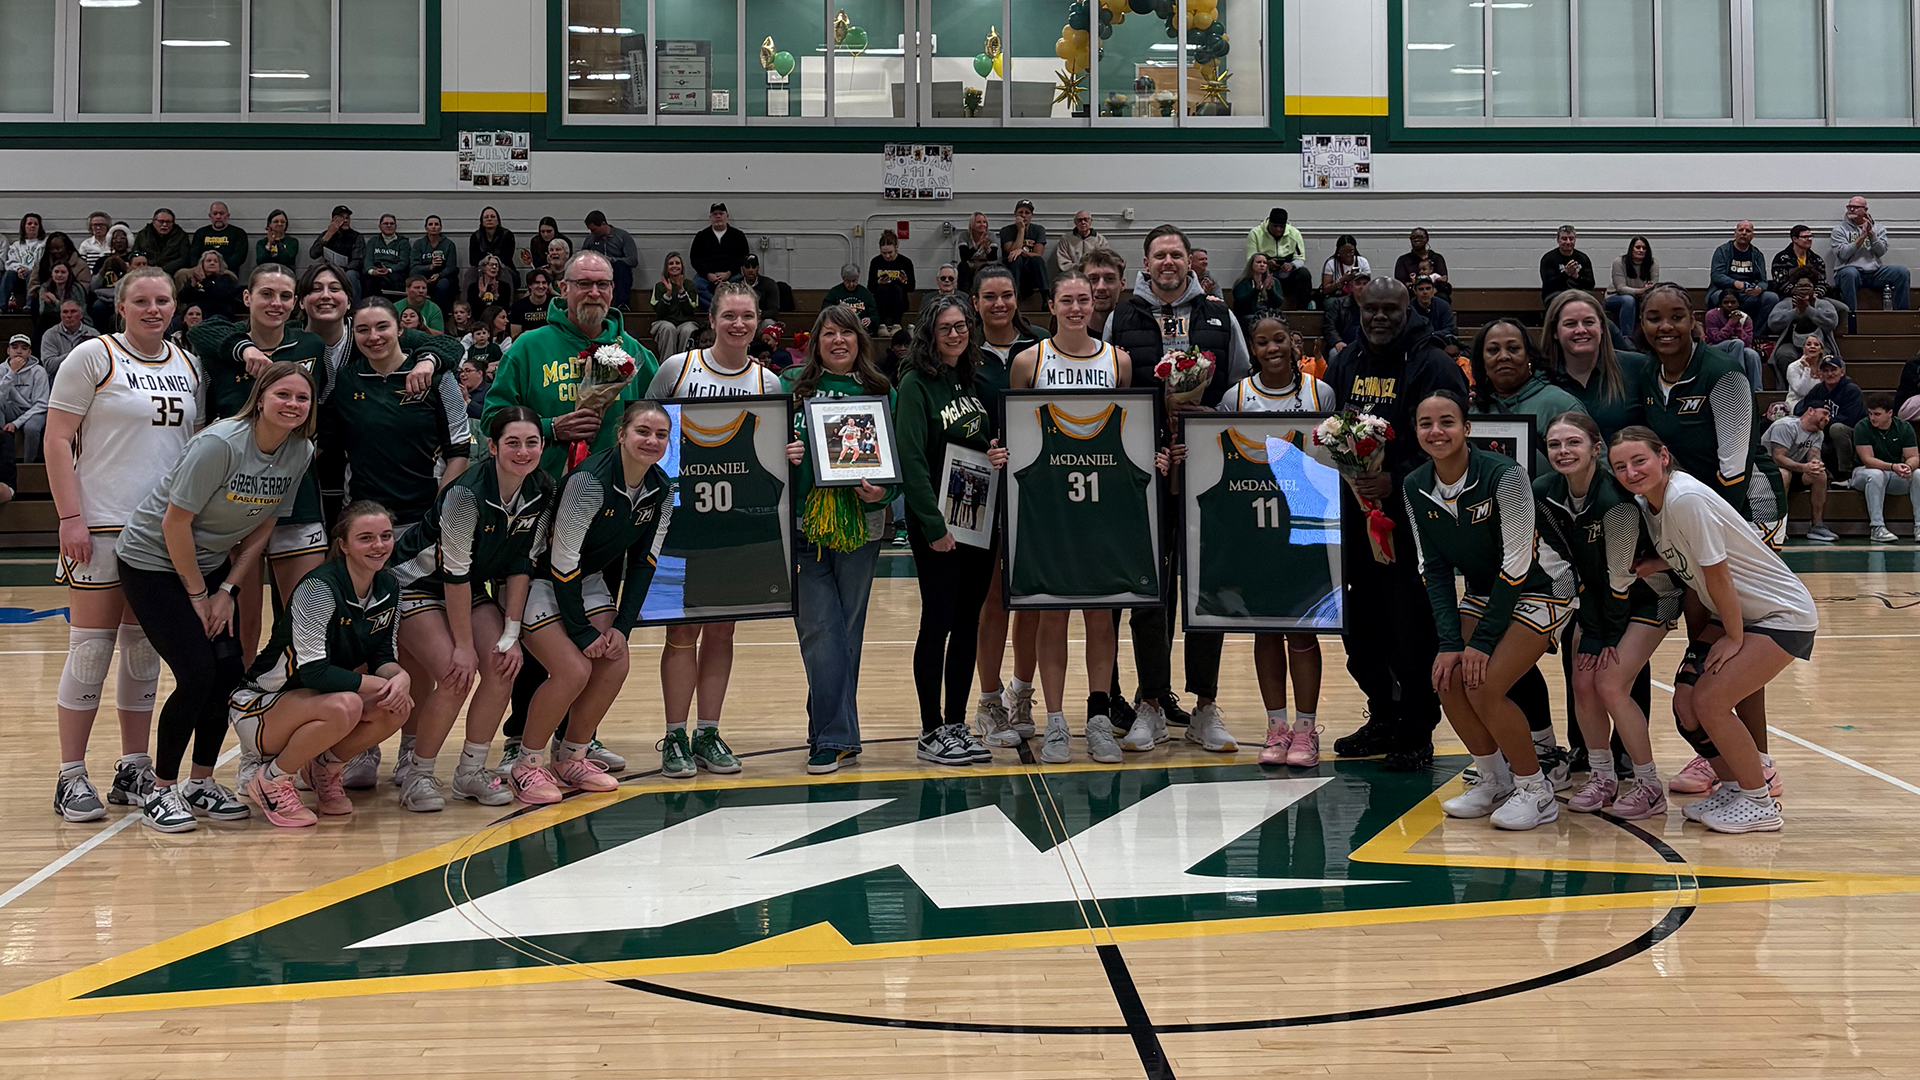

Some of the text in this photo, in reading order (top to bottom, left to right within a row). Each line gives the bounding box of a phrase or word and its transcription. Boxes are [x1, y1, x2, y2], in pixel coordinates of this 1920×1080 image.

[476, 147, 510, 160] LILY
[1310, 142, 1359, 156] ELAINA
[471, 161, 515, 174] HINES
[887, 154, 953, 172] JORDAN
[1327, 154, 1344, 166] 31
[910, 166, 925, 177] 11
[1308, 163, 1359, 178] BECKETT
[510, 174, 529, 186] 30
[884, 172, 950, 189] MCLEAN
[126, 372, 192, 393] McDANIEL
[1047, 368, 1110, 388] McDANIEL
[150, 395, 185, 427] 35
[1049, 453, 1118, 466] McDANIEL
[679, 461, 750, 476] McDANIEL
[1067, 471, 1100, 503] 31
[1228, 479, 1300, 491] McDANIEL
[694, 480, 734, 513] 30
[1251, 496, 1280, 528] 11
